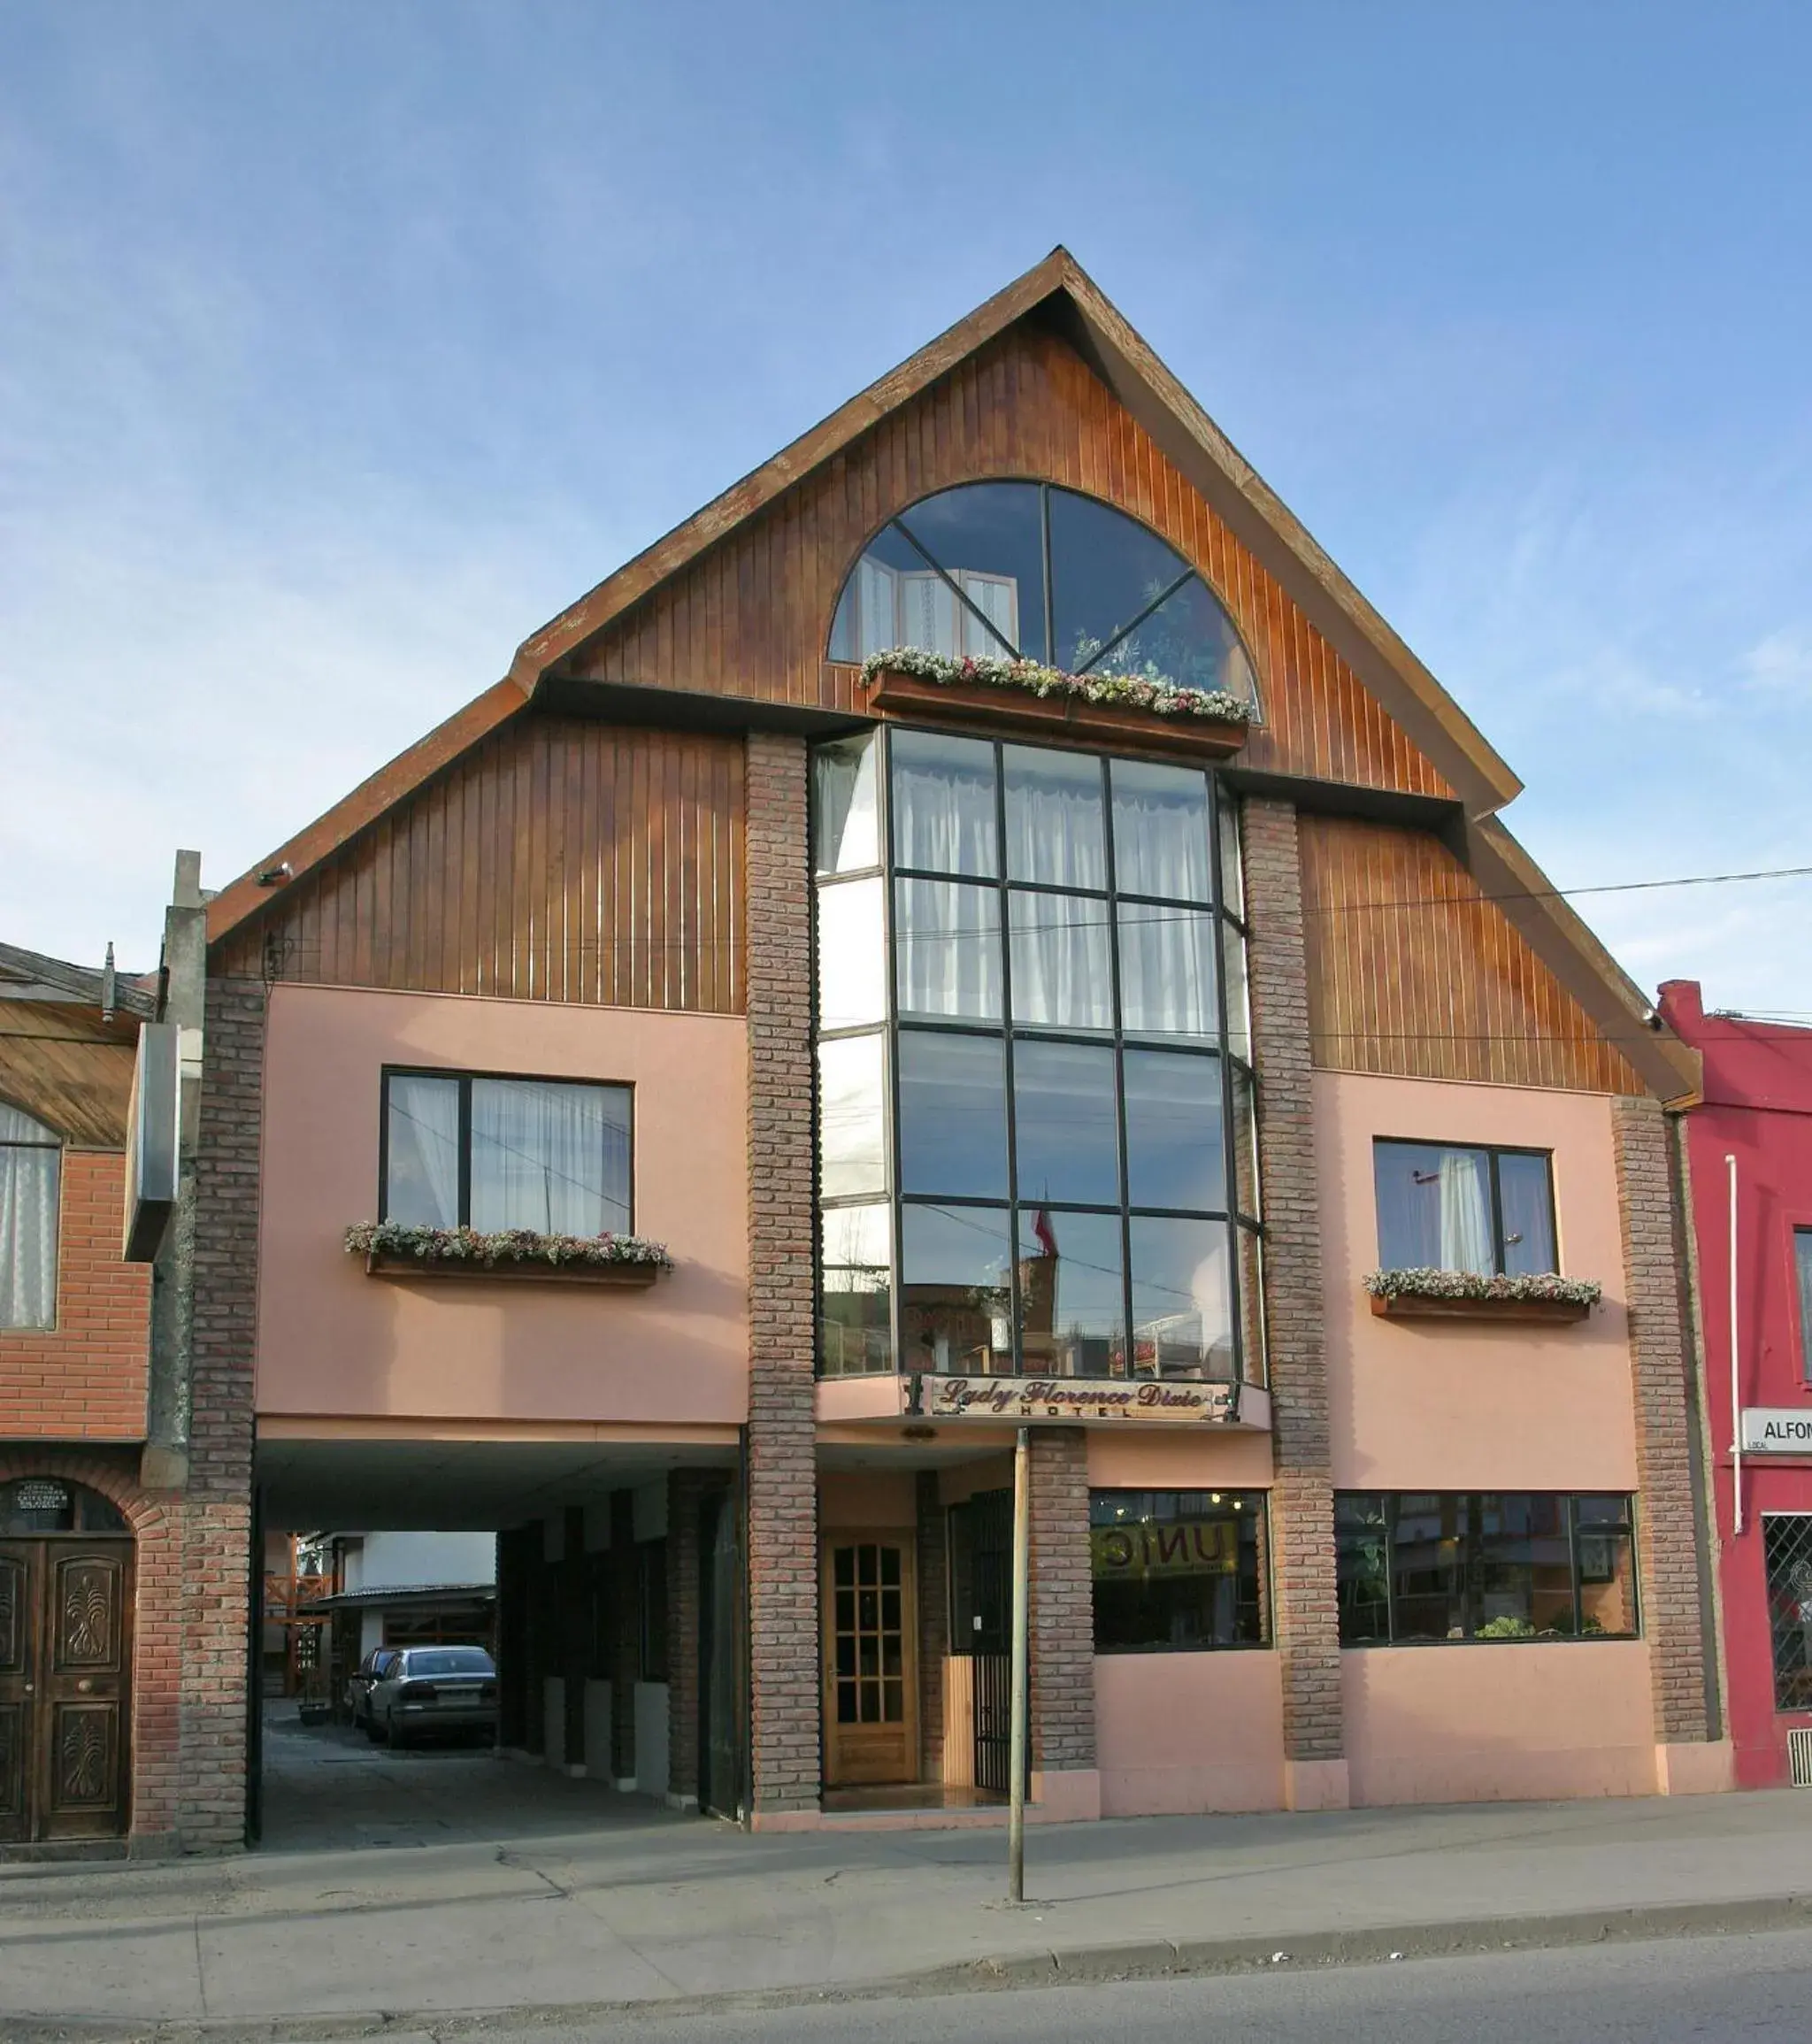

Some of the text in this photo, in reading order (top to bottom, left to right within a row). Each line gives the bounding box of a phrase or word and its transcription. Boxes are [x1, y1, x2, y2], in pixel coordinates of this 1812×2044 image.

[940, 1379, 1202, 1412] Lady Florence Dixie
[1021, 1405, 1132, 1418] HOTEL
